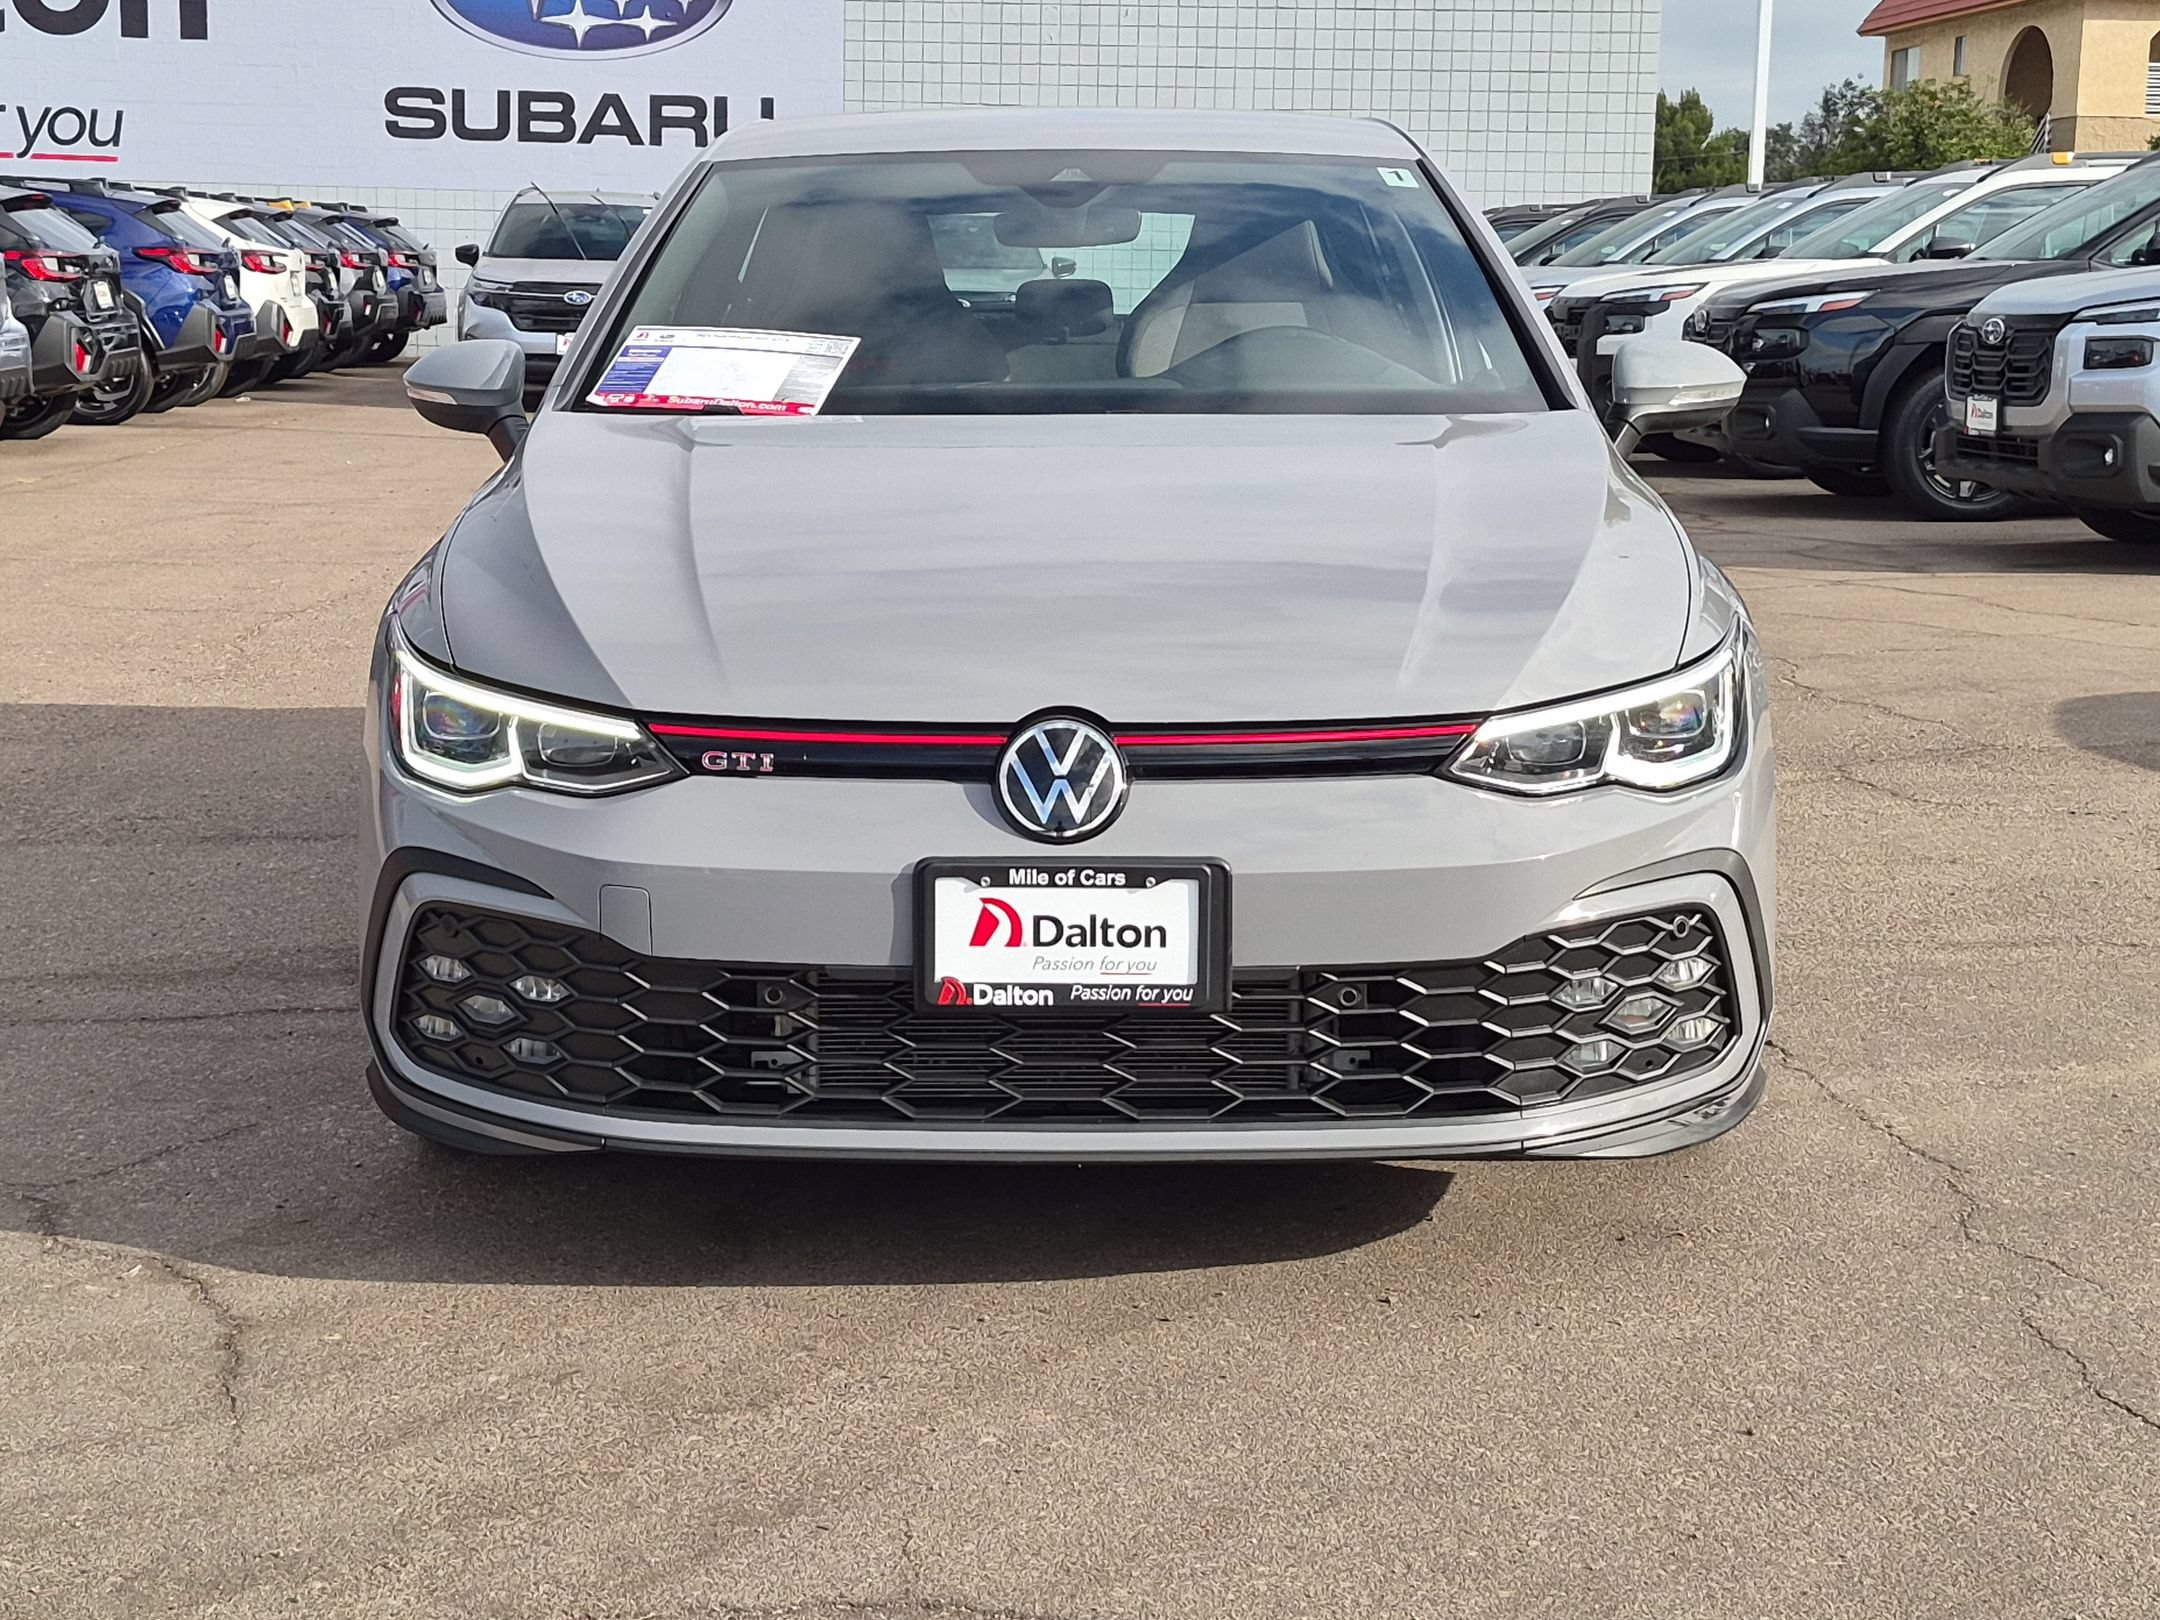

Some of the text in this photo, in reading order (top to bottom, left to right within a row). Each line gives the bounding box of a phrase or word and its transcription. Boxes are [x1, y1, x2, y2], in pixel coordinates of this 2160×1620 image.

[16, 105, 124, 158] you
[701, 750, 775, 772] GTI
[1009, 868, 1126, 886] Mile of Cars
[1033, 914, 1167, 948] Dalton
[1032, 956, 1157, 974] Passion for you
[973, 983, 1054, 1006] Dalton
[1070, 985, 1193, 1003] Passion for you
